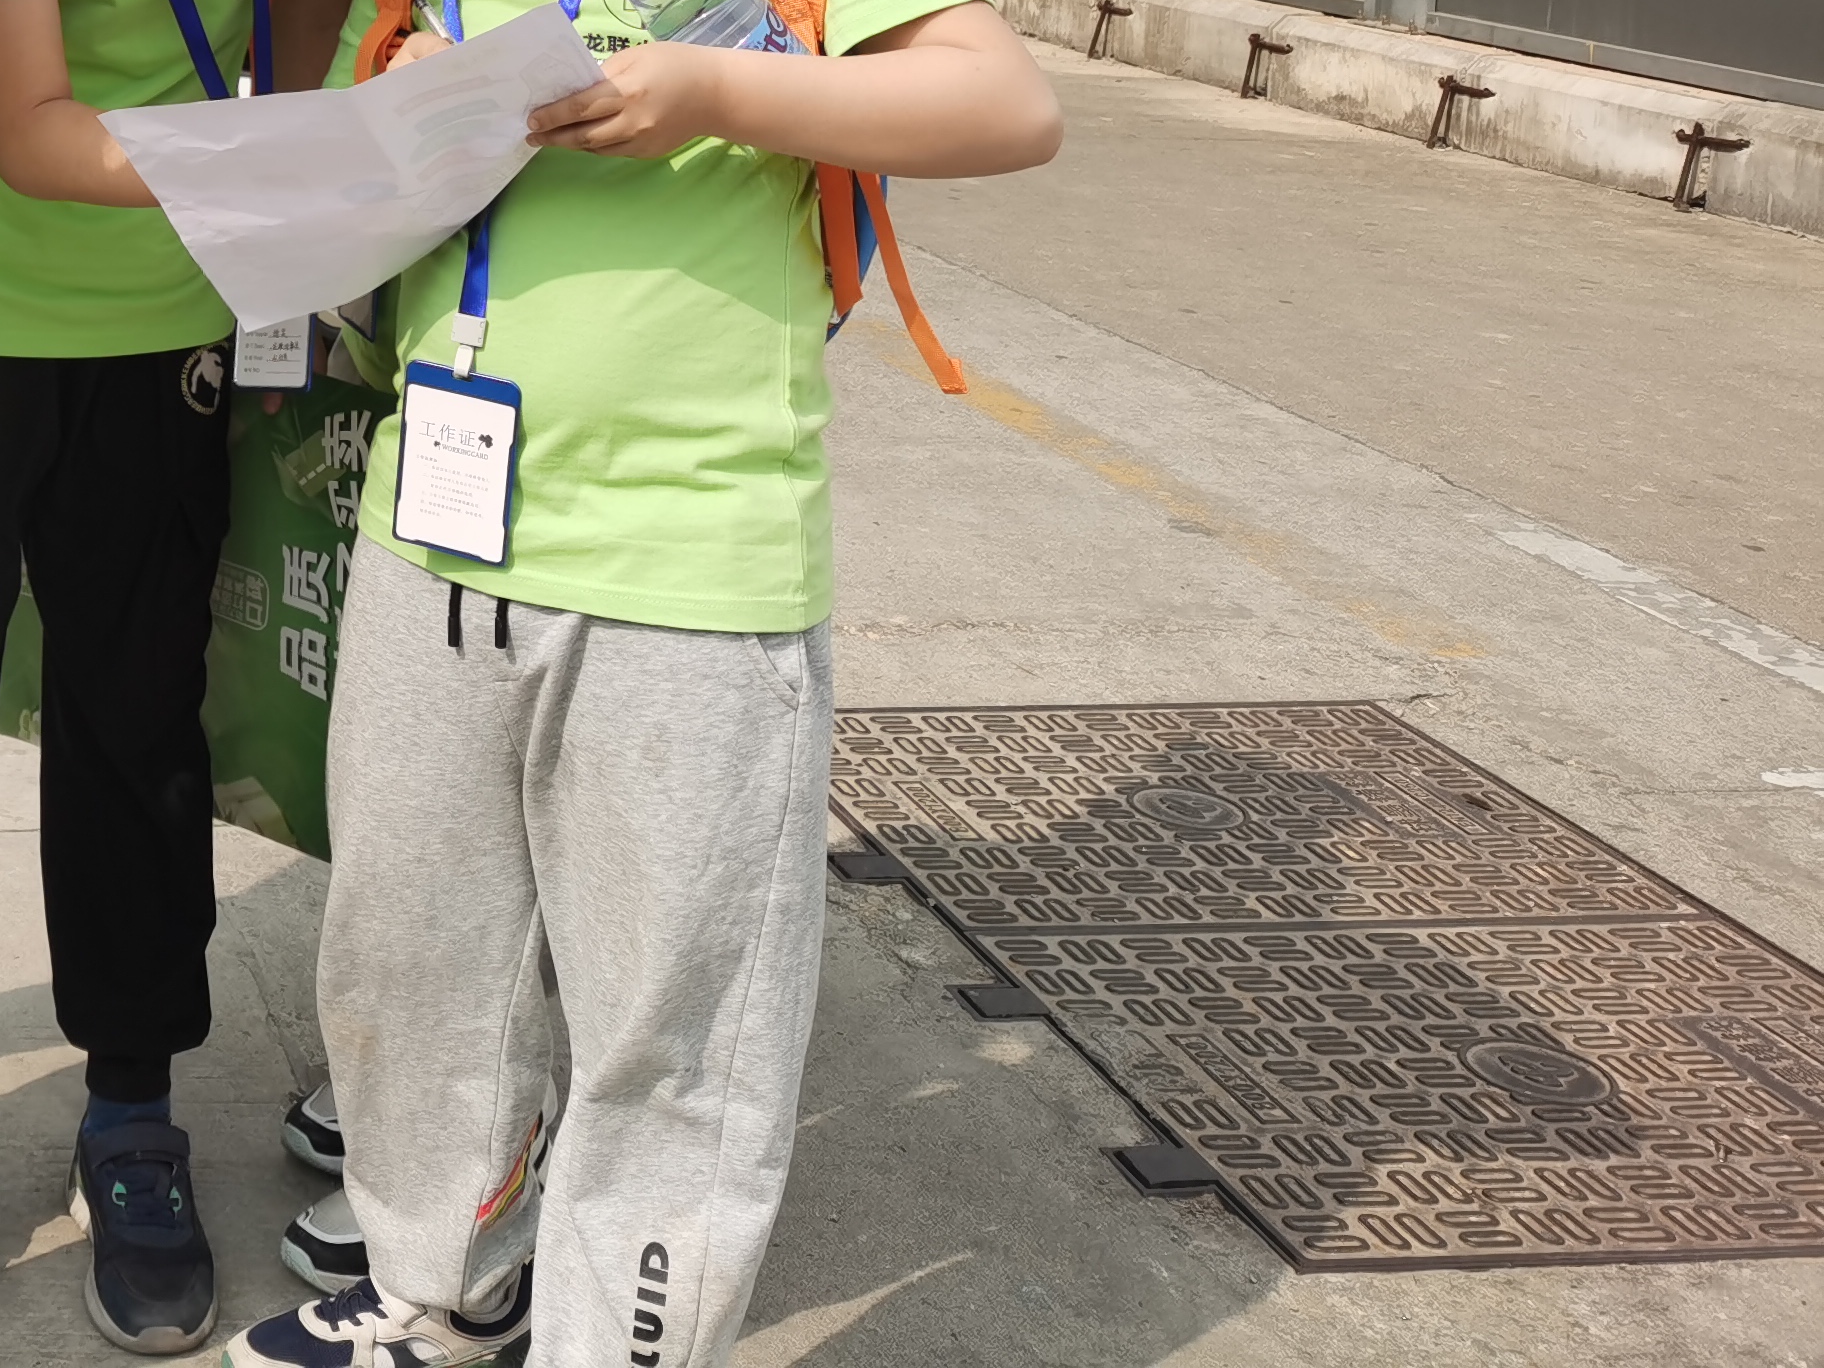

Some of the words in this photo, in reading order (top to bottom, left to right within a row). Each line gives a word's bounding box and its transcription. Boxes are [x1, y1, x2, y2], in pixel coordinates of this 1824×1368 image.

[419, 421, 476, 448] 工作证
[280, 544, 331, 701] 品质
[630, 1241, 670, 1368] LUID
